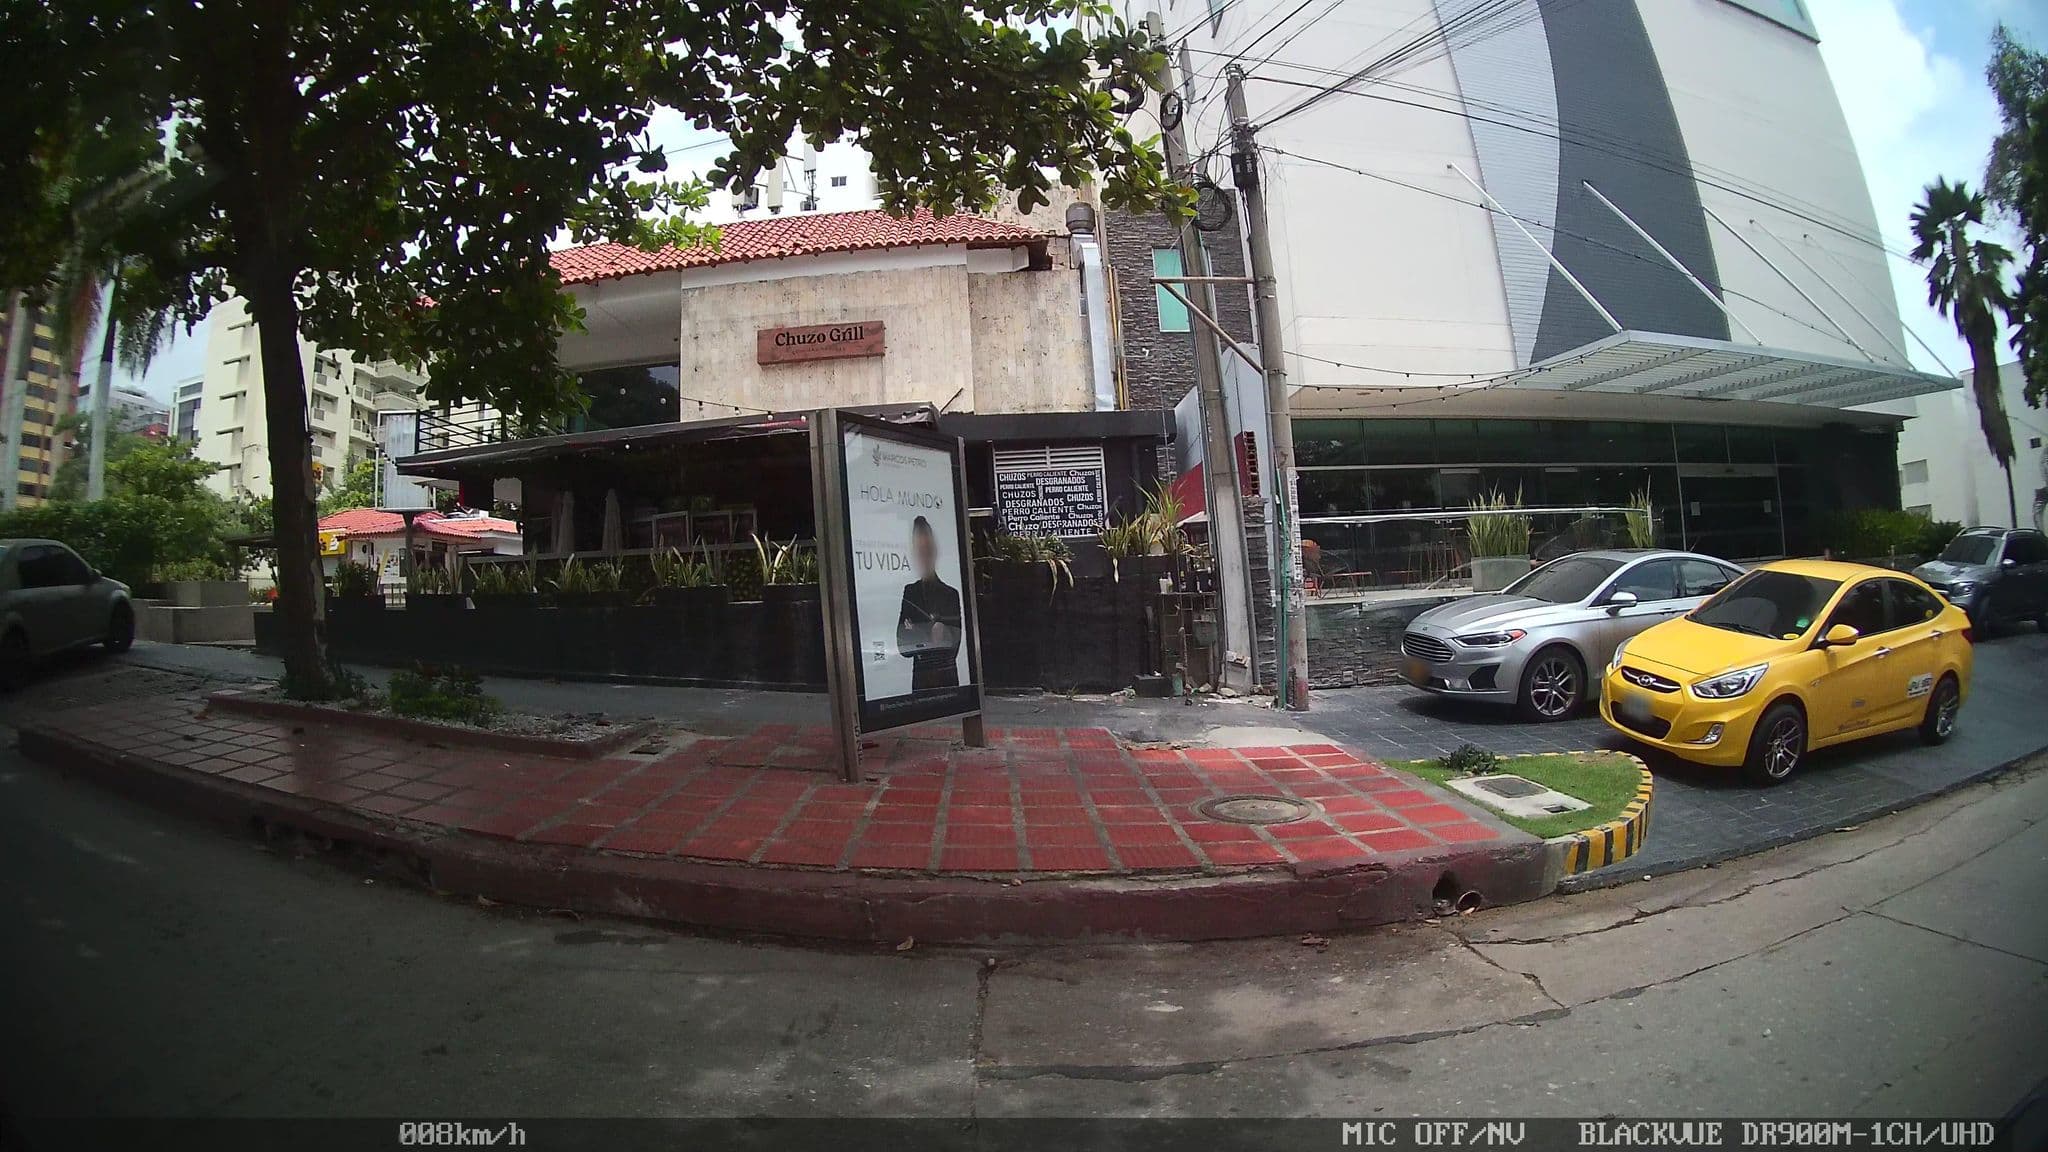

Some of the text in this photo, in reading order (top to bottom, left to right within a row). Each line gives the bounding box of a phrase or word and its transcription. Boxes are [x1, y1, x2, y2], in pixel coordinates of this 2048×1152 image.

[775, 325, 865, 347] Chuzo Grill
[999, 472, 1026, 482] CHUZOS
[1036, 476, 1086, 485] DESGRANADOS
[1063, 484, 1089, 493] CALIENTE
[860, 484, 943, 510] HOLA MUNDO
[1002, 490, 1037, 499] CHUZOS
[1066, 493, 1094, 502] CHUZOS
[1005, 498, 1065, 508] DESGRANADOS
[1032, 506, 1076, 514] CALIENTE
[1042, 518, 1098, 529] DESGRANADOS
[855, 551, 911, 571] TU VIDA
